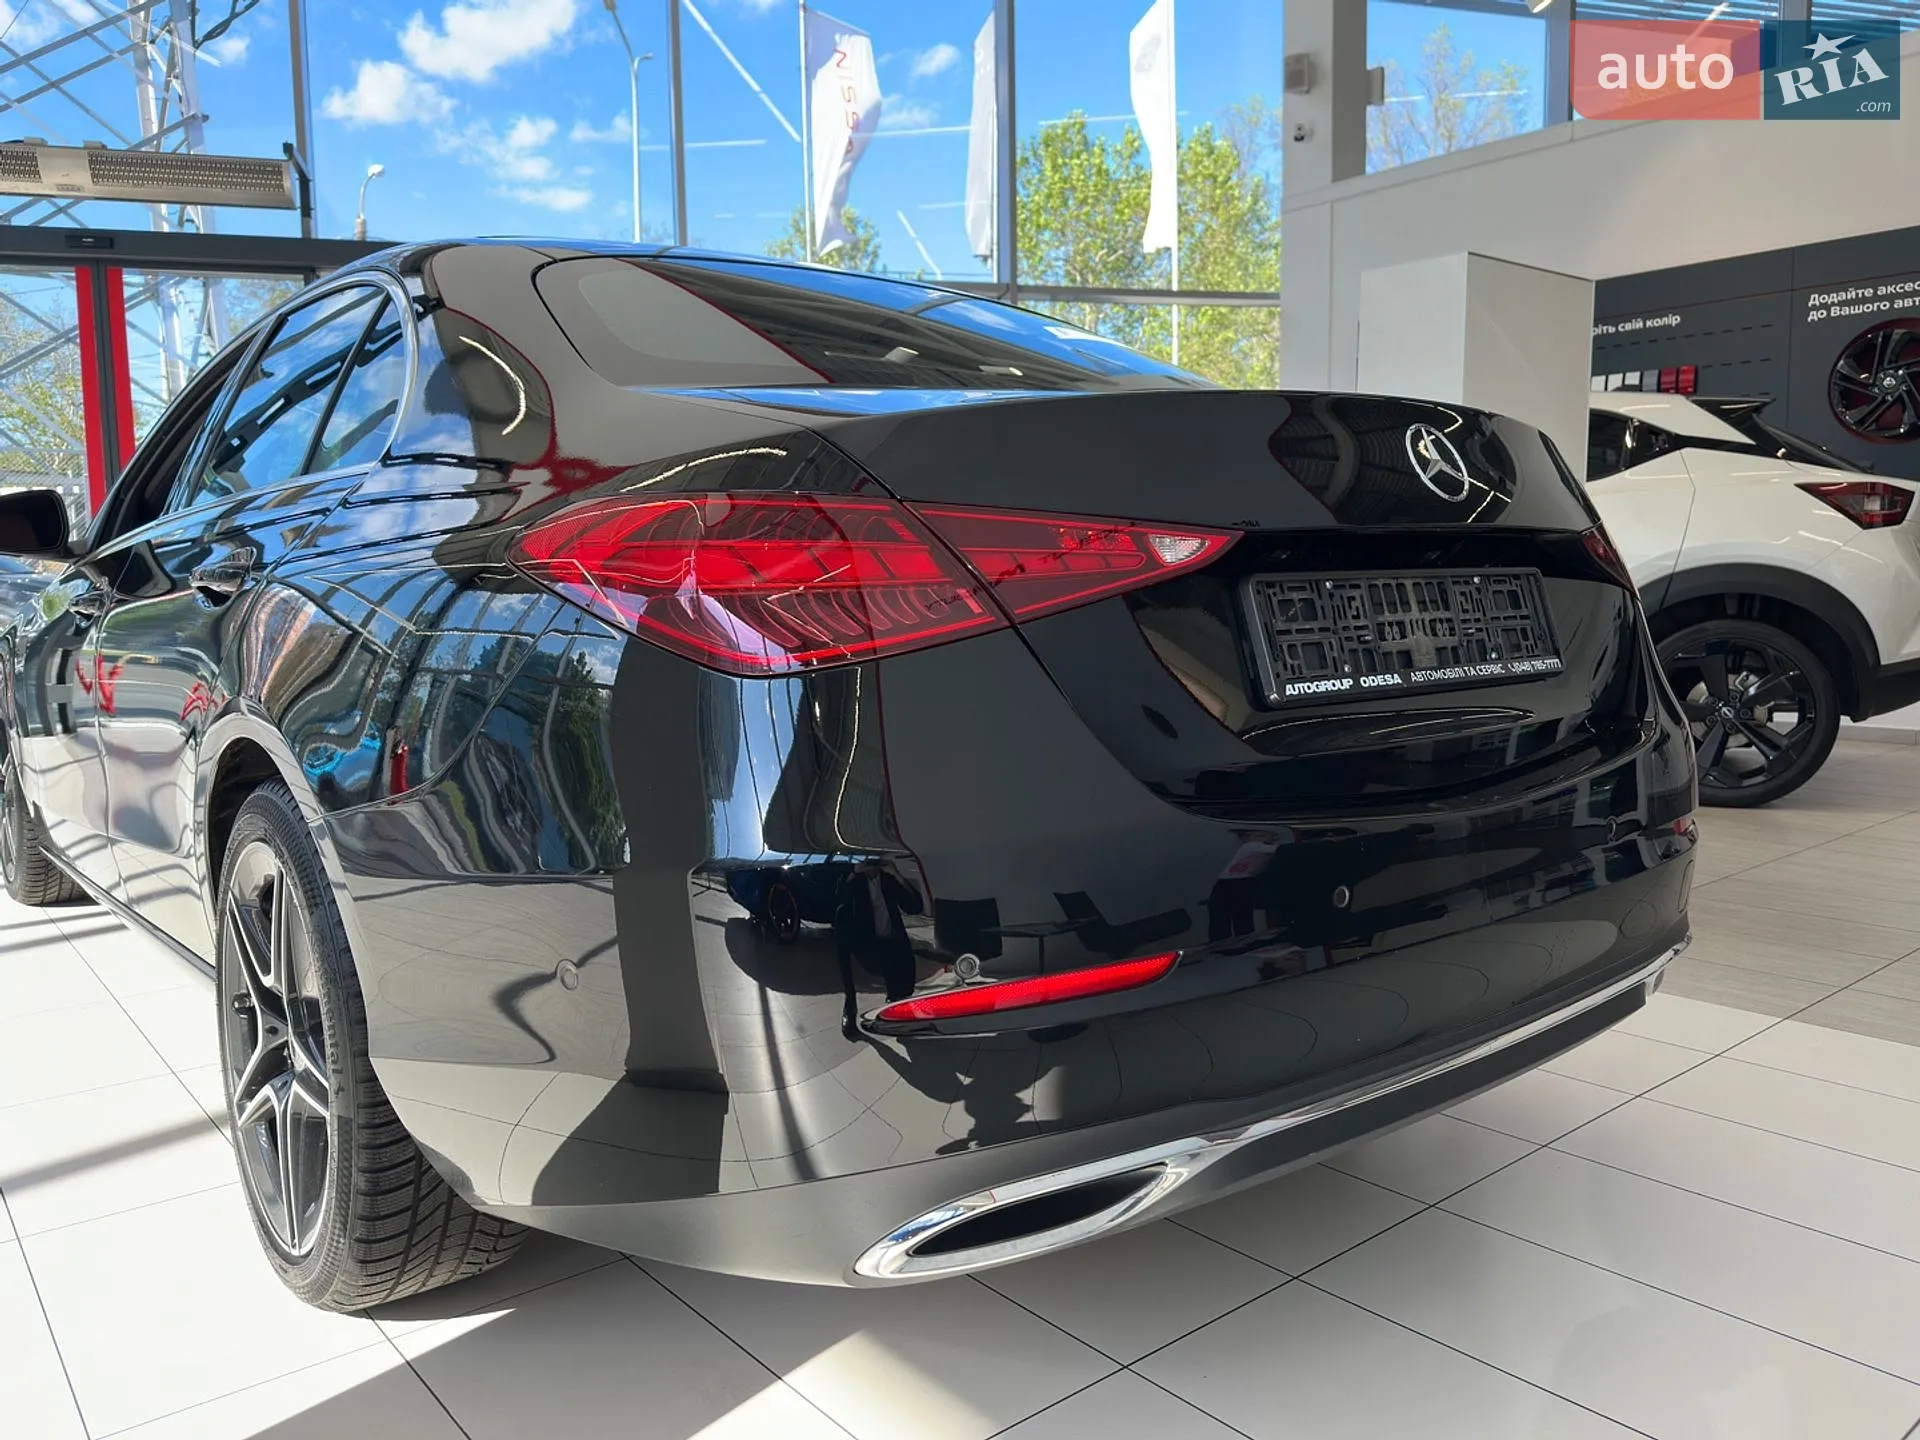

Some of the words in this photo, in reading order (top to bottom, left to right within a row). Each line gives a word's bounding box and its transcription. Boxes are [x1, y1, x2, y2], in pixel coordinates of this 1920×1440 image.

[834, 47, 860, 155] NISSA
[1807, 287, 1874, 308] Додайте
[1618, 318, 1643, 332] свій
[1646, 313, 1681, 327] колір
[1807, 309, 1827, 323] до
[1830, 301, 1890, 317] Вашого
[1465, 666, 1478, 677] ТА
[1285, 678, 1354, 696] AUTOGROUP
[1360, 673, 1402, 687] ODESA
